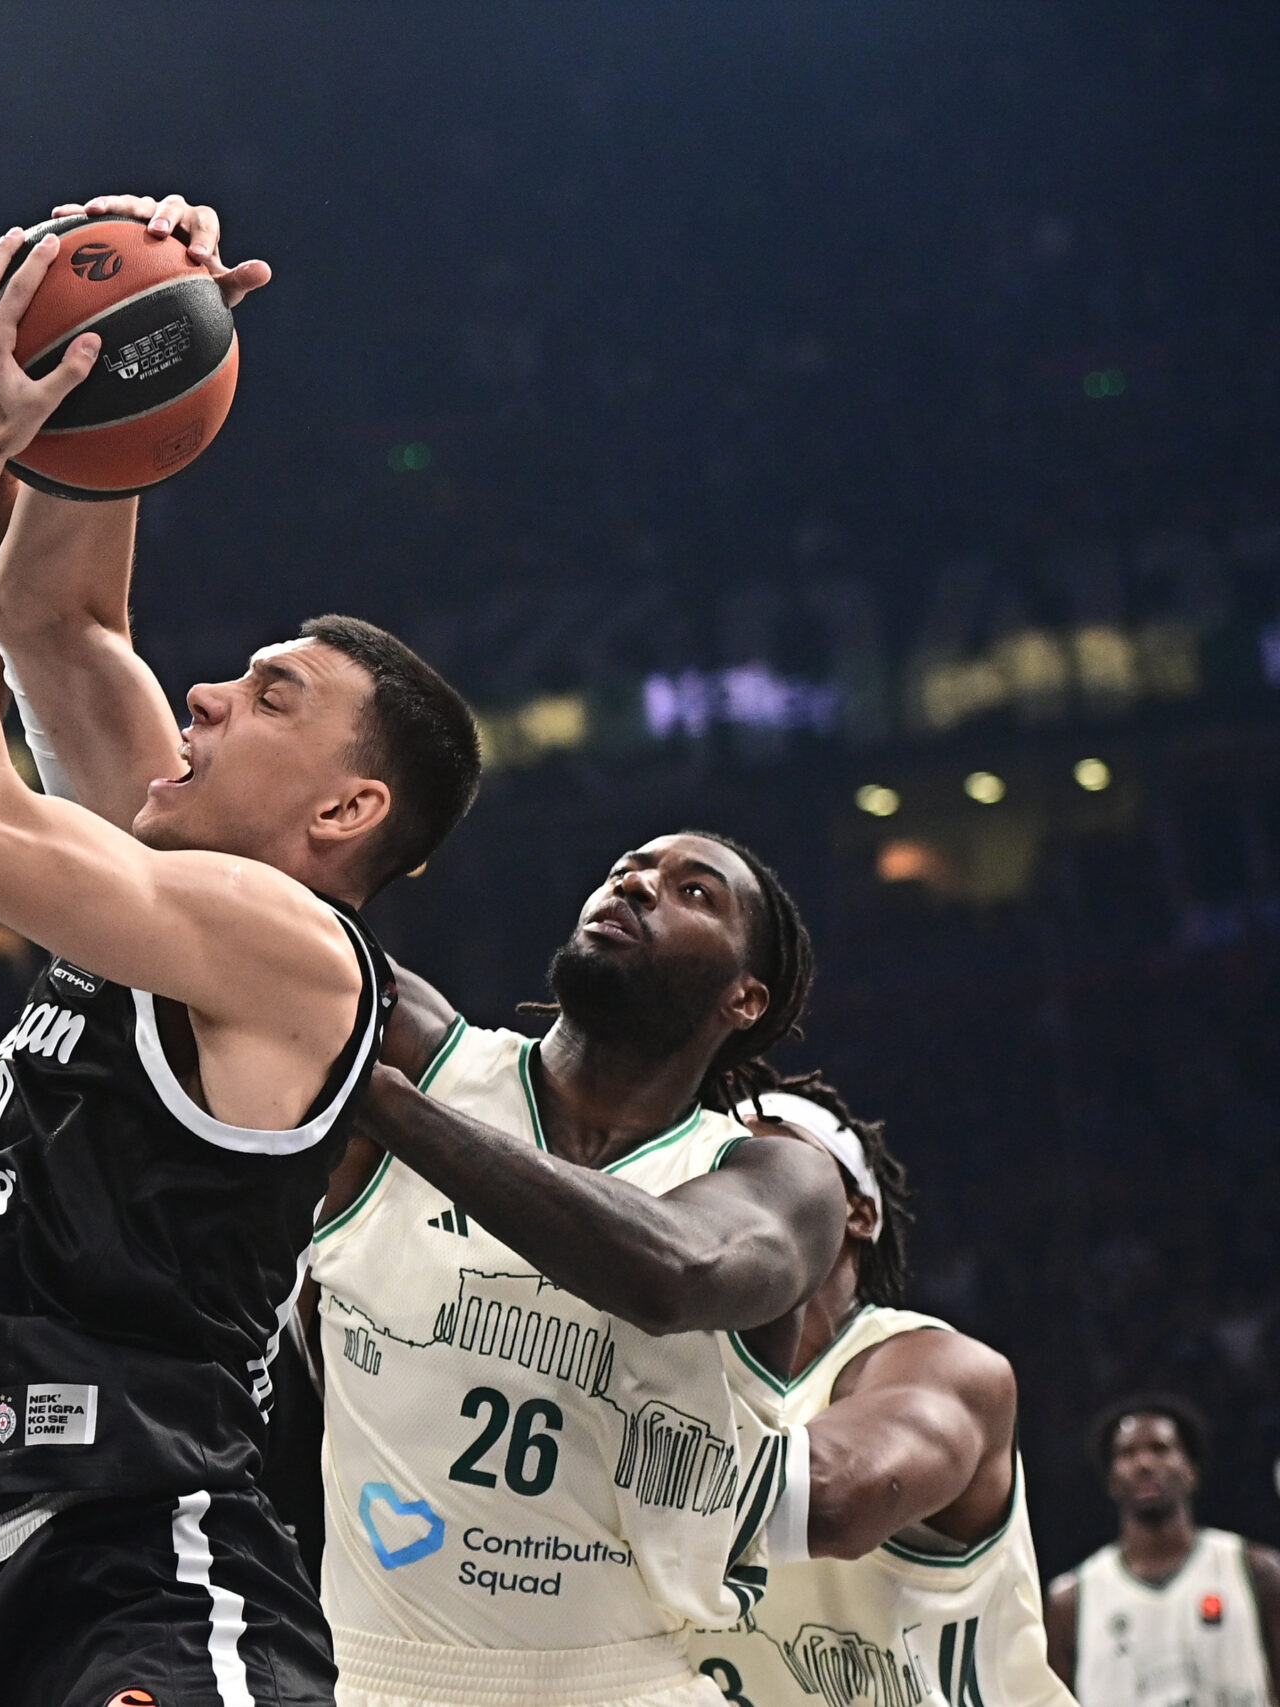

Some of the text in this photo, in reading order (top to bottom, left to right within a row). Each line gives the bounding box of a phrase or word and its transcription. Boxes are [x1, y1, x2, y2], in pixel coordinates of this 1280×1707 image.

[103, 315, 190, 372] LEGACY
[53, 968, 95, 993] ETIHAD
[28, 1405, 85, 1415] NE IGRA
[28, 1415, 68, 1425] KO SE
[27, 1425, 66, 1436] LOMI!
[448, 1386, 563, 1497] 26
[458, 1561, 561, 1596] Squad
